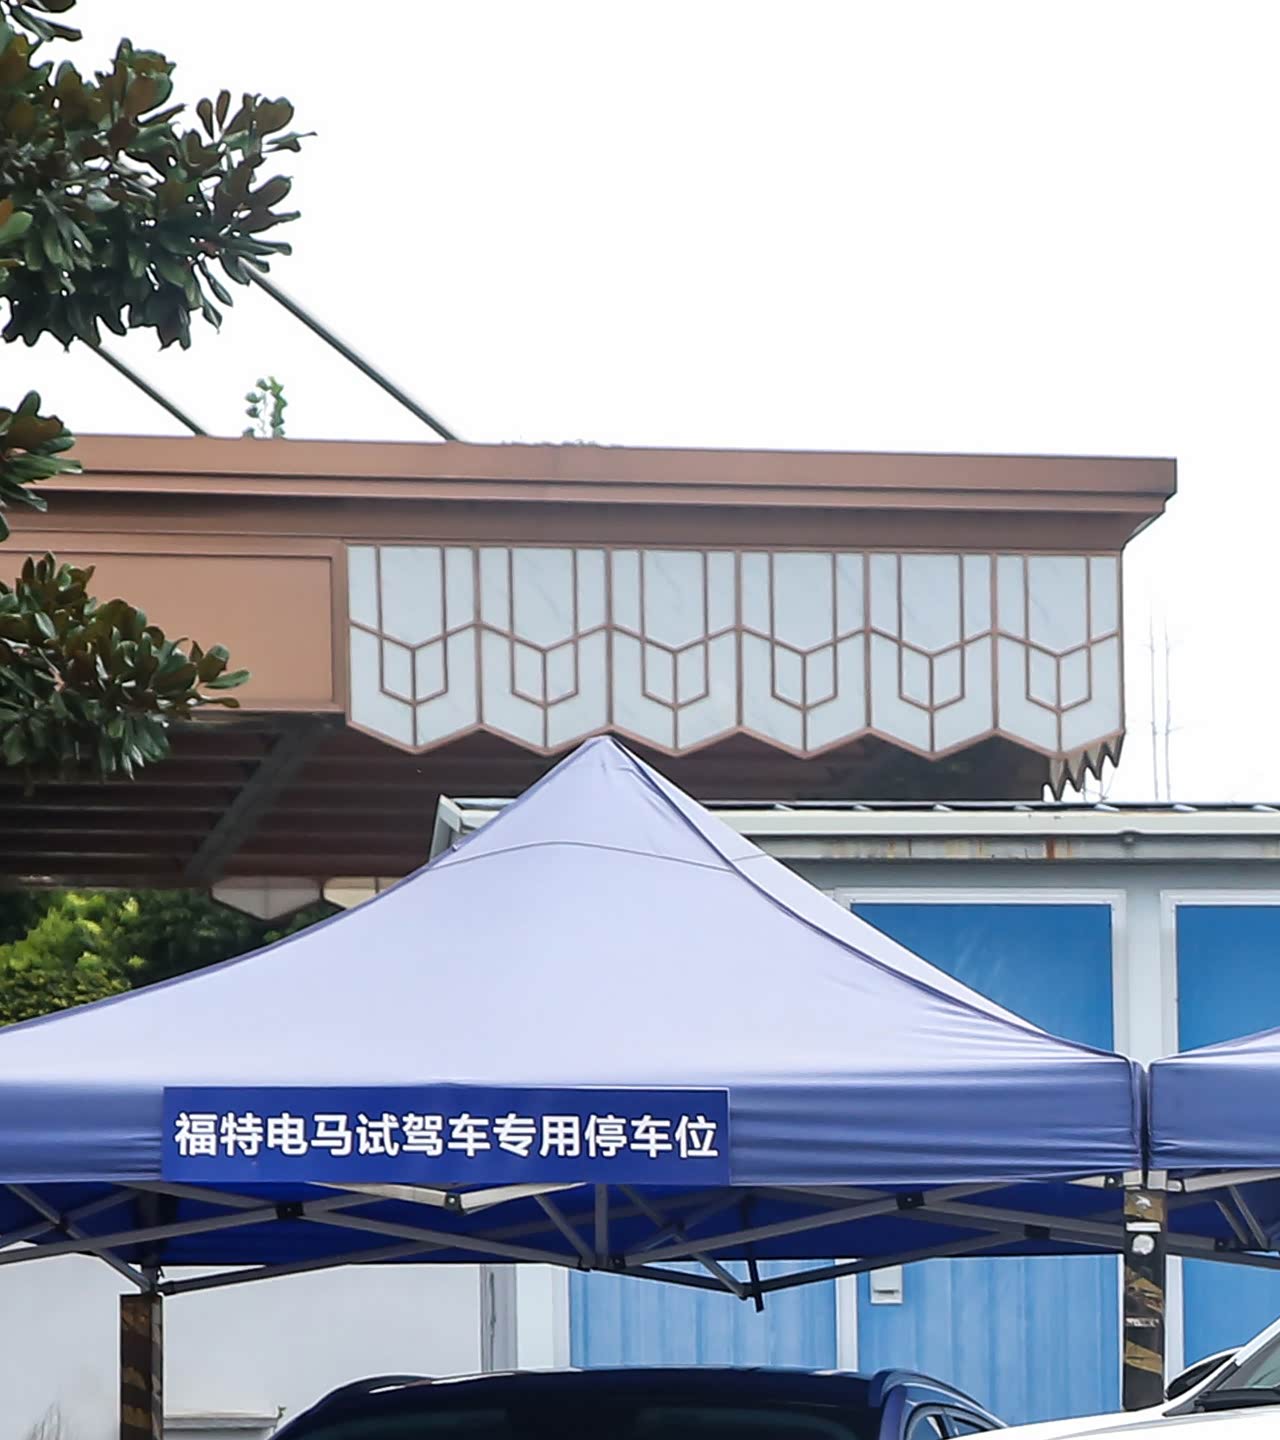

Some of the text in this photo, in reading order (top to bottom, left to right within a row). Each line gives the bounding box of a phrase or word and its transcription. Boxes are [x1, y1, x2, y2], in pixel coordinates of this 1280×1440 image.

[174, 1112, 719, 1157] 福特电马试驾车专用停车位
